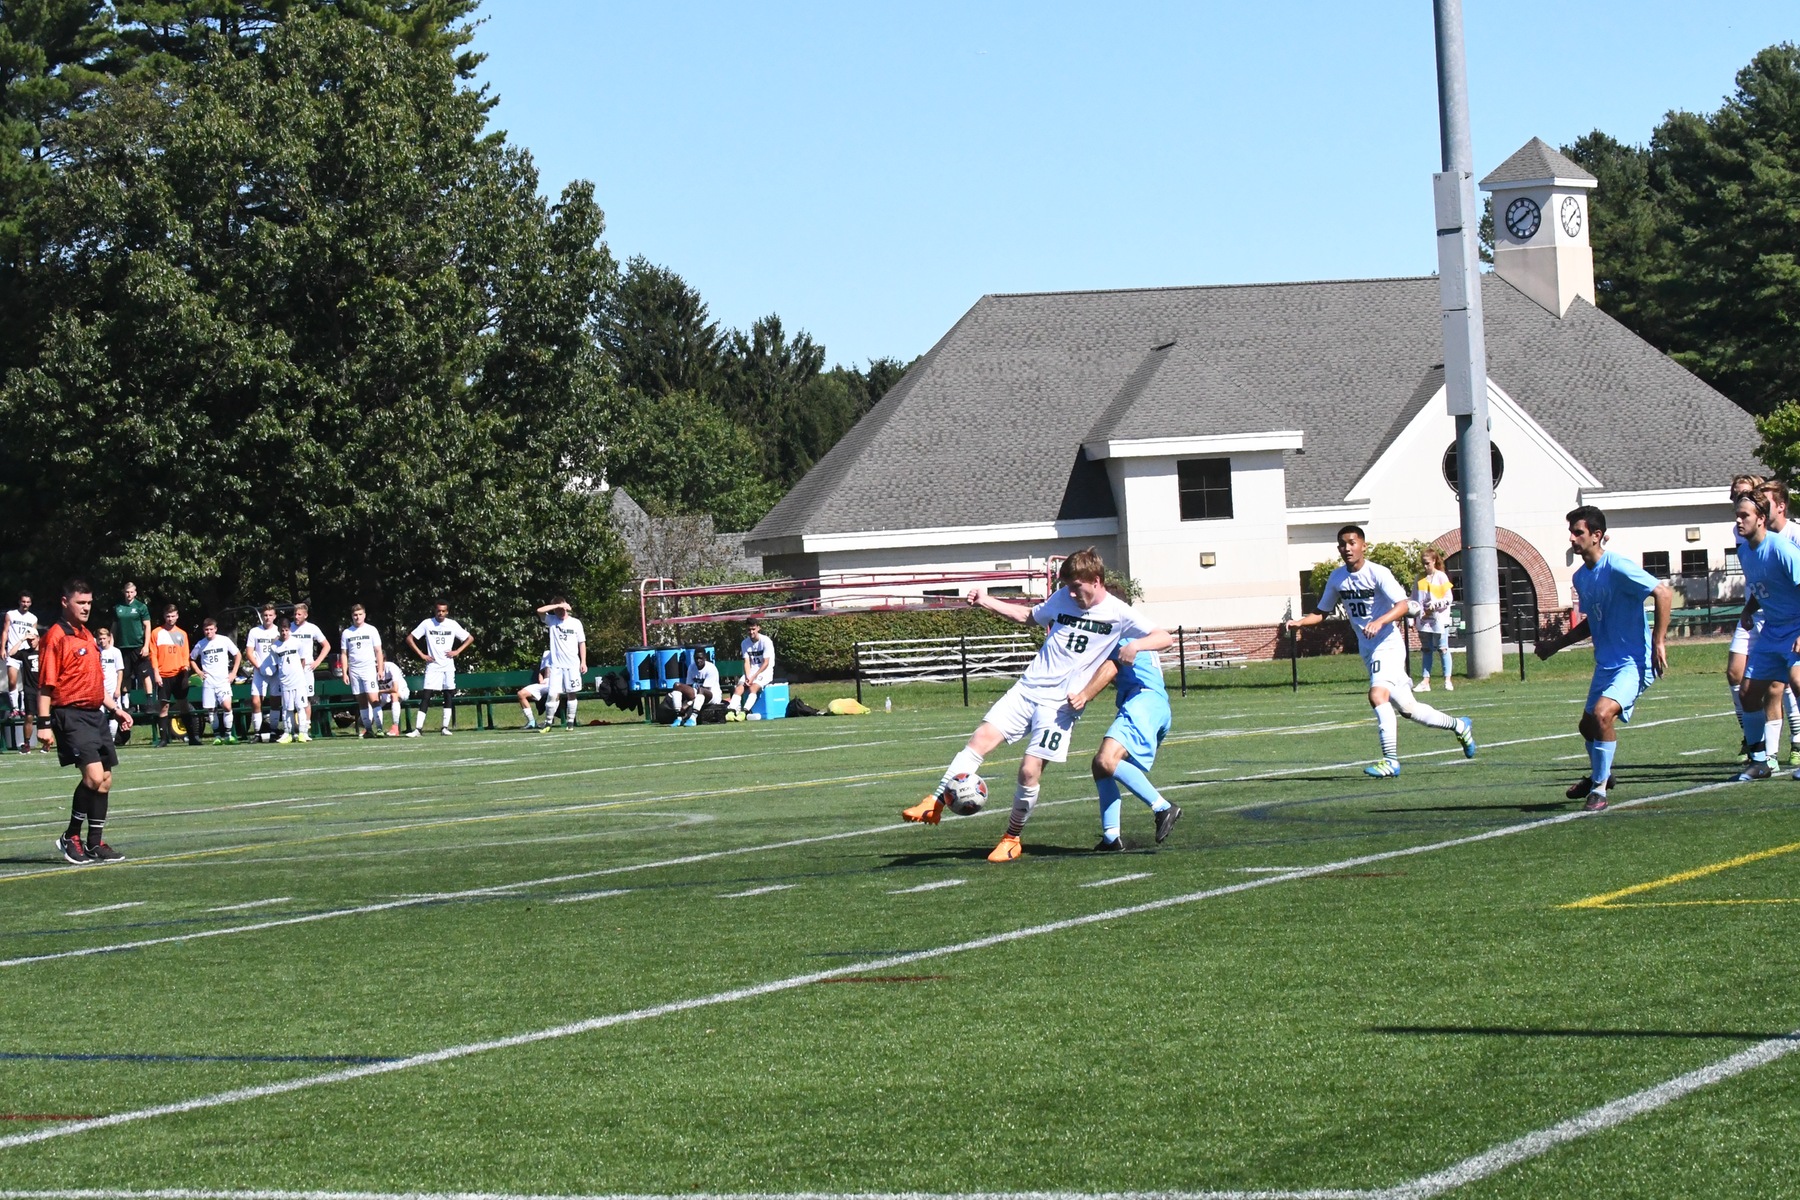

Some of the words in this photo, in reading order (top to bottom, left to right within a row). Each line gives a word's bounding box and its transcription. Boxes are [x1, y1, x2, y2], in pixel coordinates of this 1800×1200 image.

[1349, 602, 1366, 618] 20
[1057, 613, 1113, 635] MUSTANGS
[1066, 632, 1088, 654] 18
[210, 655, 218, 663] 26
[570, 679, 580, 688] 23
[1039, 729, 1062, 751] 18
